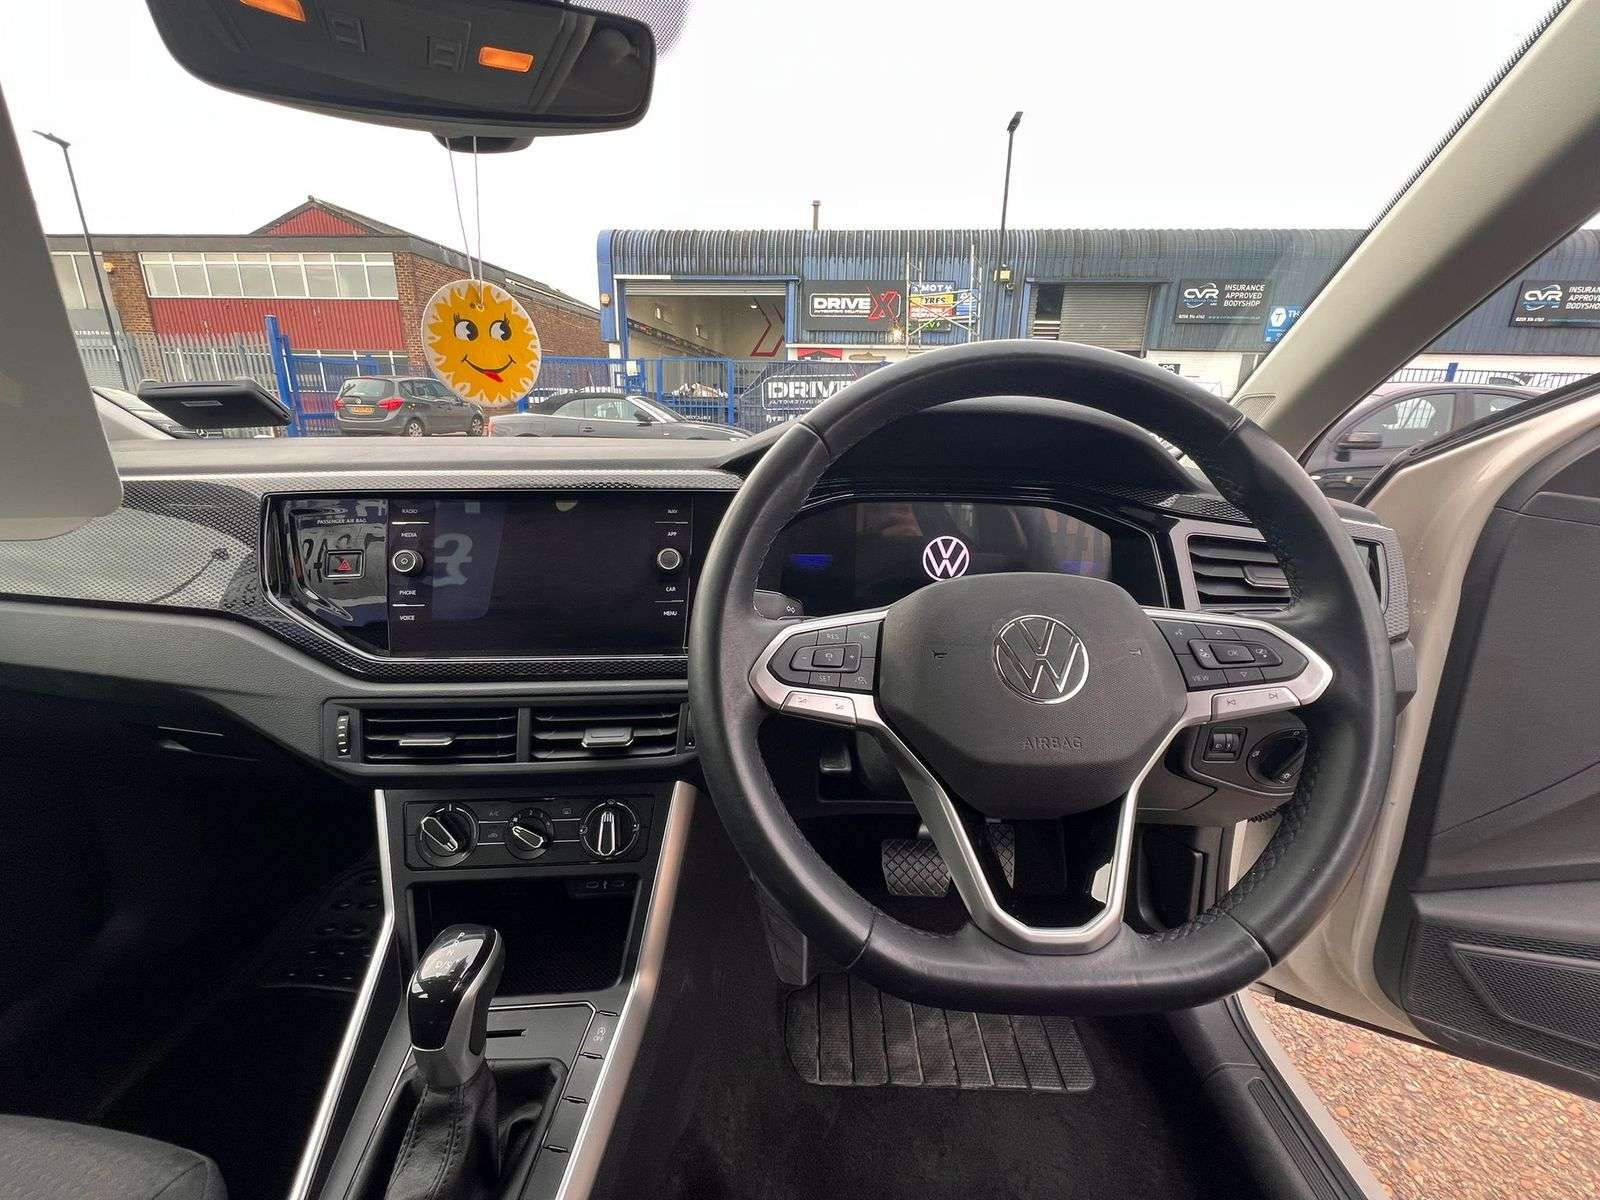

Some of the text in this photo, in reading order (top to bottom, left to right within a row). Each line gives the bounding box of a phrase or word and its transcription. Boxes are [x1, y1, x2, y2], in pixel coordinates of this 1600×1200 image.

[921, 284, 944, 292] MOT
[1184, 288, 1219, 299] CVR
[1224, 284, 1265, 292] INSURANCE
[1524, 290, 1563, 301] CVR
[813, 297, 871, 310] DRIVE
[1024, 736, 1083, 750] AIRBAG
